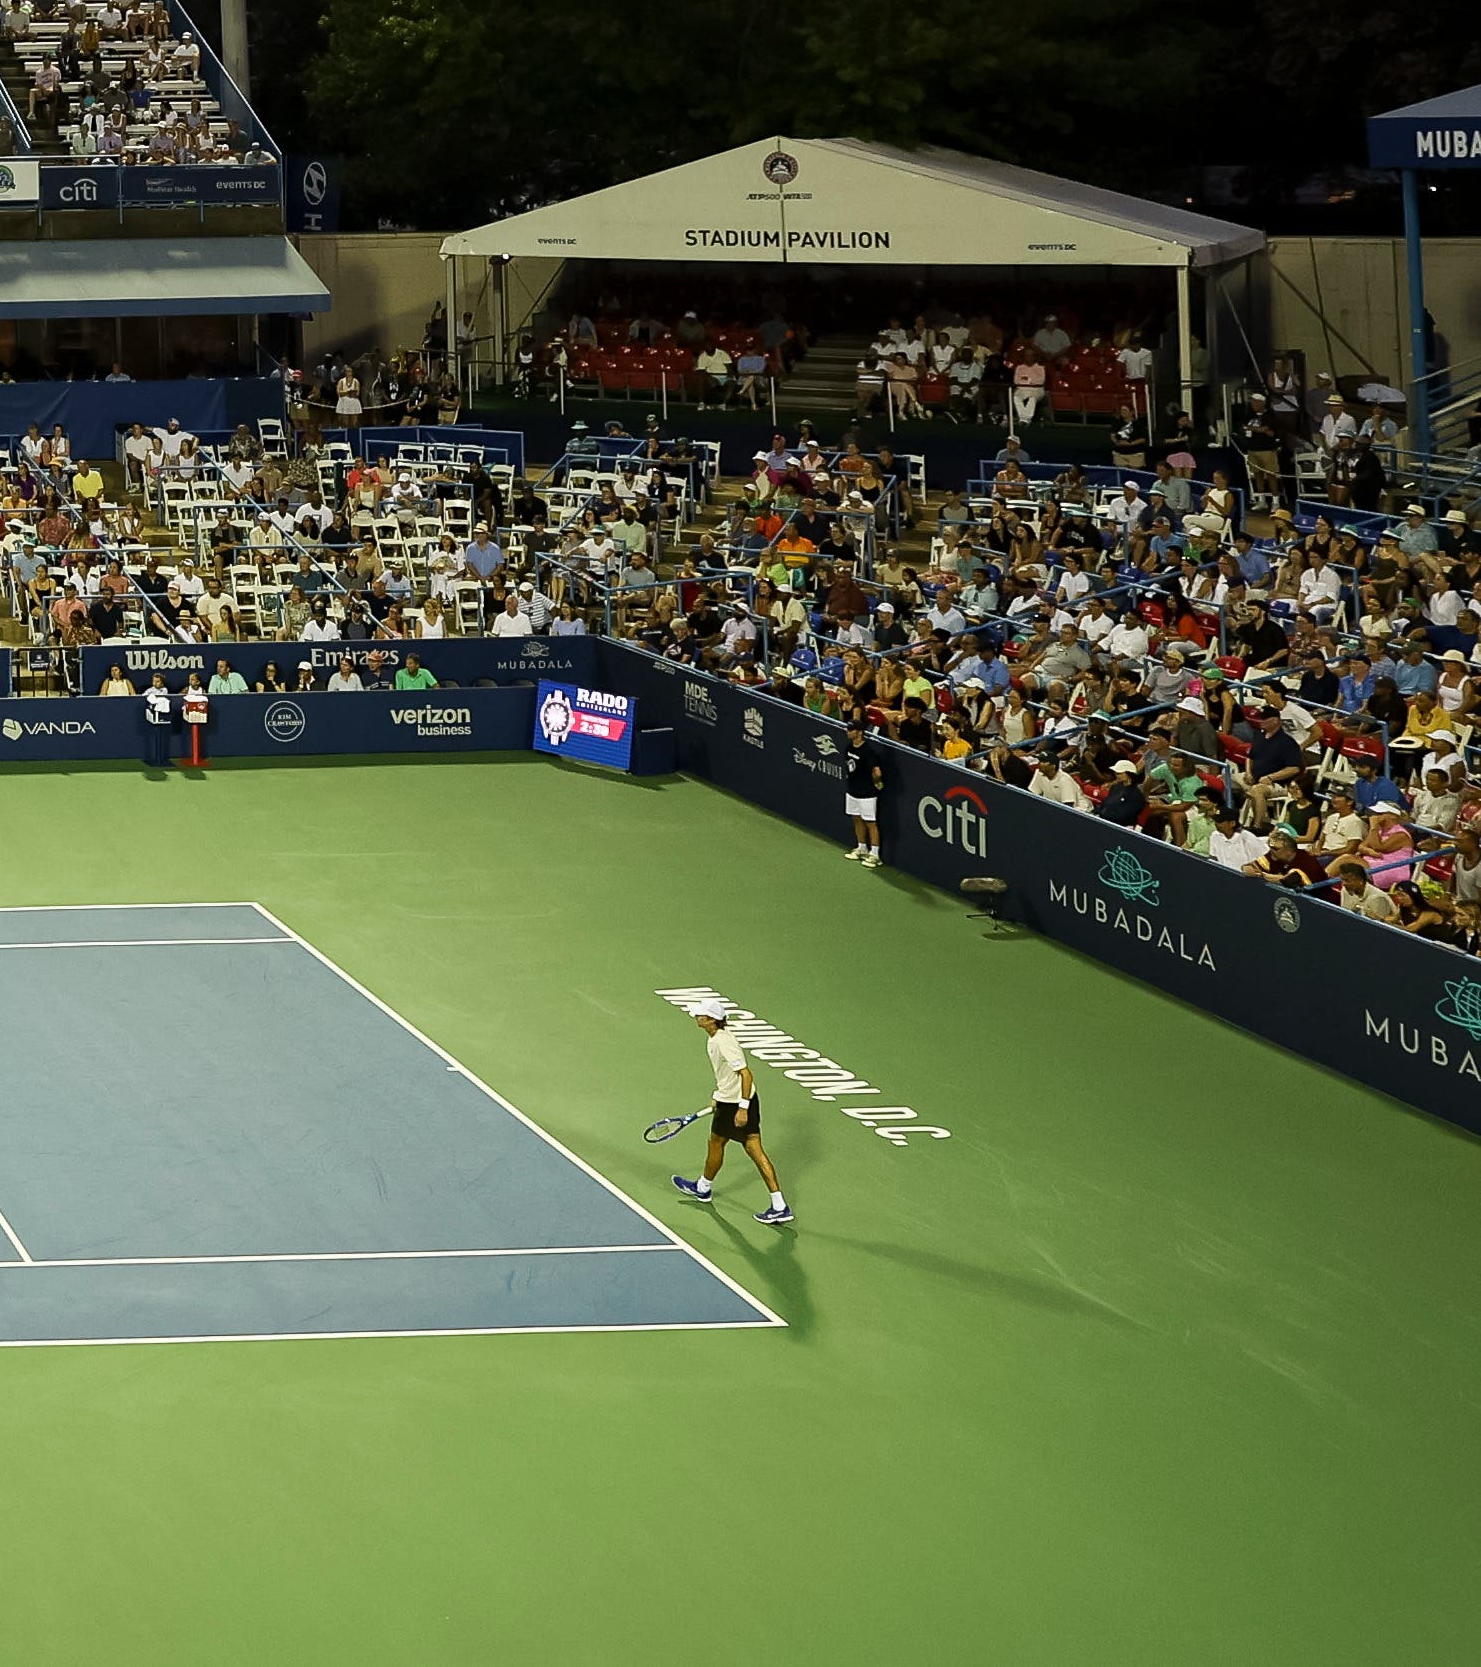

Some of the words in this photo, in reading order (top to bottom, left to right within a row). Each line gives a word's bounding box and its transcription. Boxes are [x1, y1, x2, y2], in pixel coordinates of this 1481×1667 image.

[59, 179, 97, 202] citi
[685, 231, 780, 248] STADIUM
[788, 232, 890, 249] PAVILION
[125, 650, 204, 670] Wilson
[497, 660, 573, 670] MUBADALA
[577, 688, 628, 710] RADO
[685, 681, 712, 702] MDE.
[390, 704, 471, 724] verizon
[684, 695, 717, 721] TENNIS
[23, 721, 96, 735] VANDA
[417, 724, 472, 736] business
[917, 786, 988, 858] citi
[1049, 878, 1217, 973] MUBADALA
